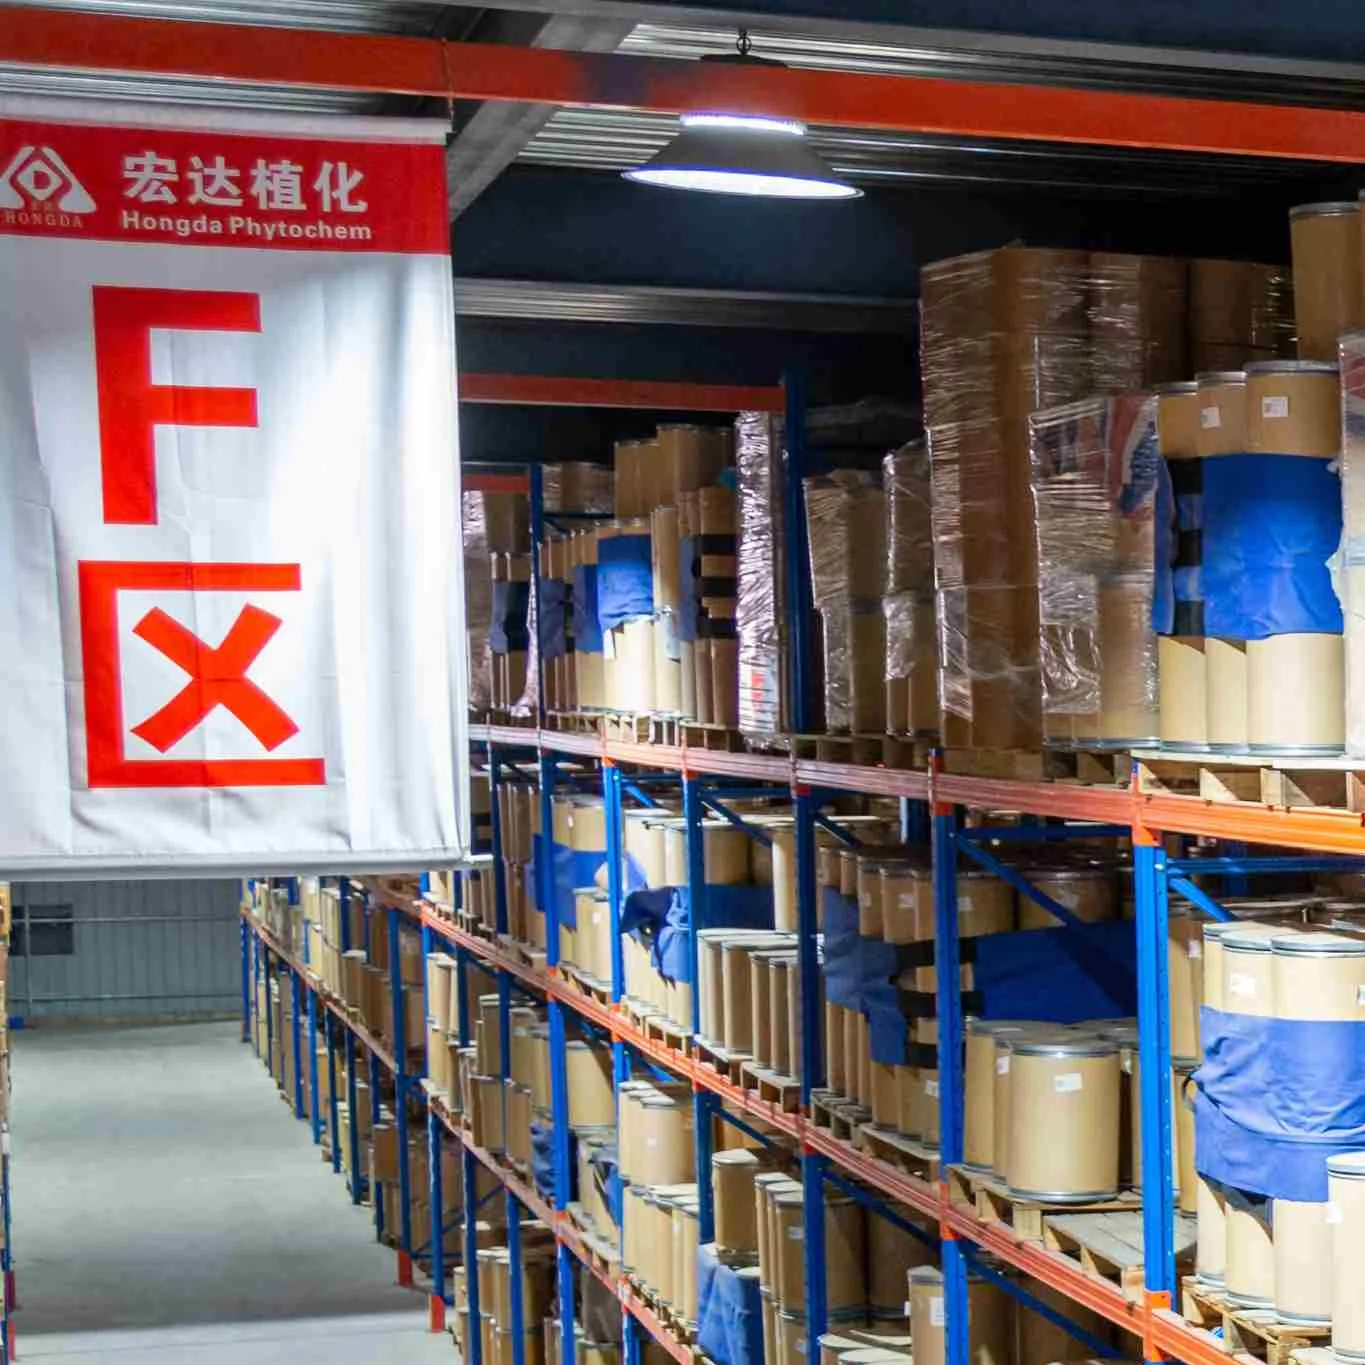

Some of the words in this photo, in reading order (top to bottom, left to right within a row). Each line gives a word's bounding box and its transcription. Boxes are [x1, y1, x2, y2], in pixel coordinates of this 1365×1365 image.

[121, 210, 223, 238] Hongda
[229, 216, 372, 241] Phytochem
[122, 151, 369, 213] 宏达植化
[93, 286, 261, 525] F
[77, 560, 326, 789] 区
